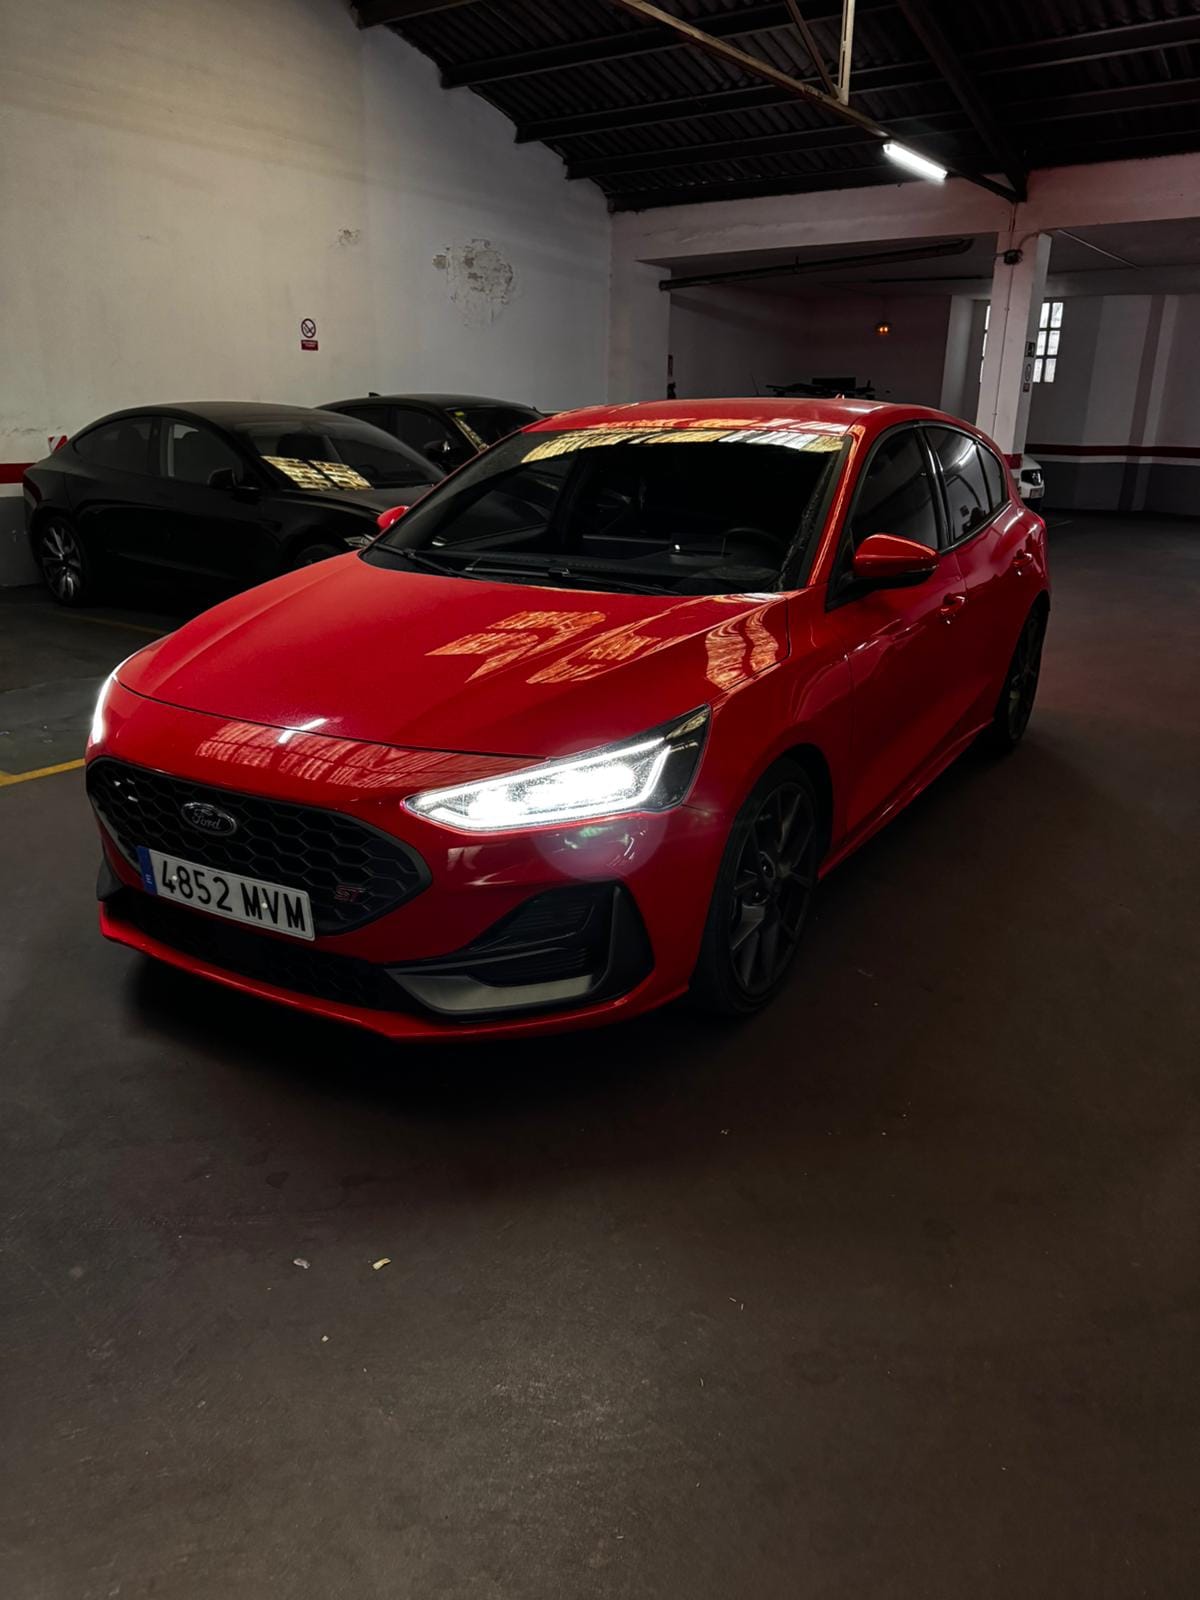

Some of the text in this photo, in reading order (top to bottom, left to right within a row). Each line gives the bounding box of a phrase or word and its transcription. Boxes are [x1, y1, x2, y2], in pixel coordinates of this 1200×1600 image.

[191, 808, 222, 830] Ford
[162, 860, 306, 932] 4852 MVM
